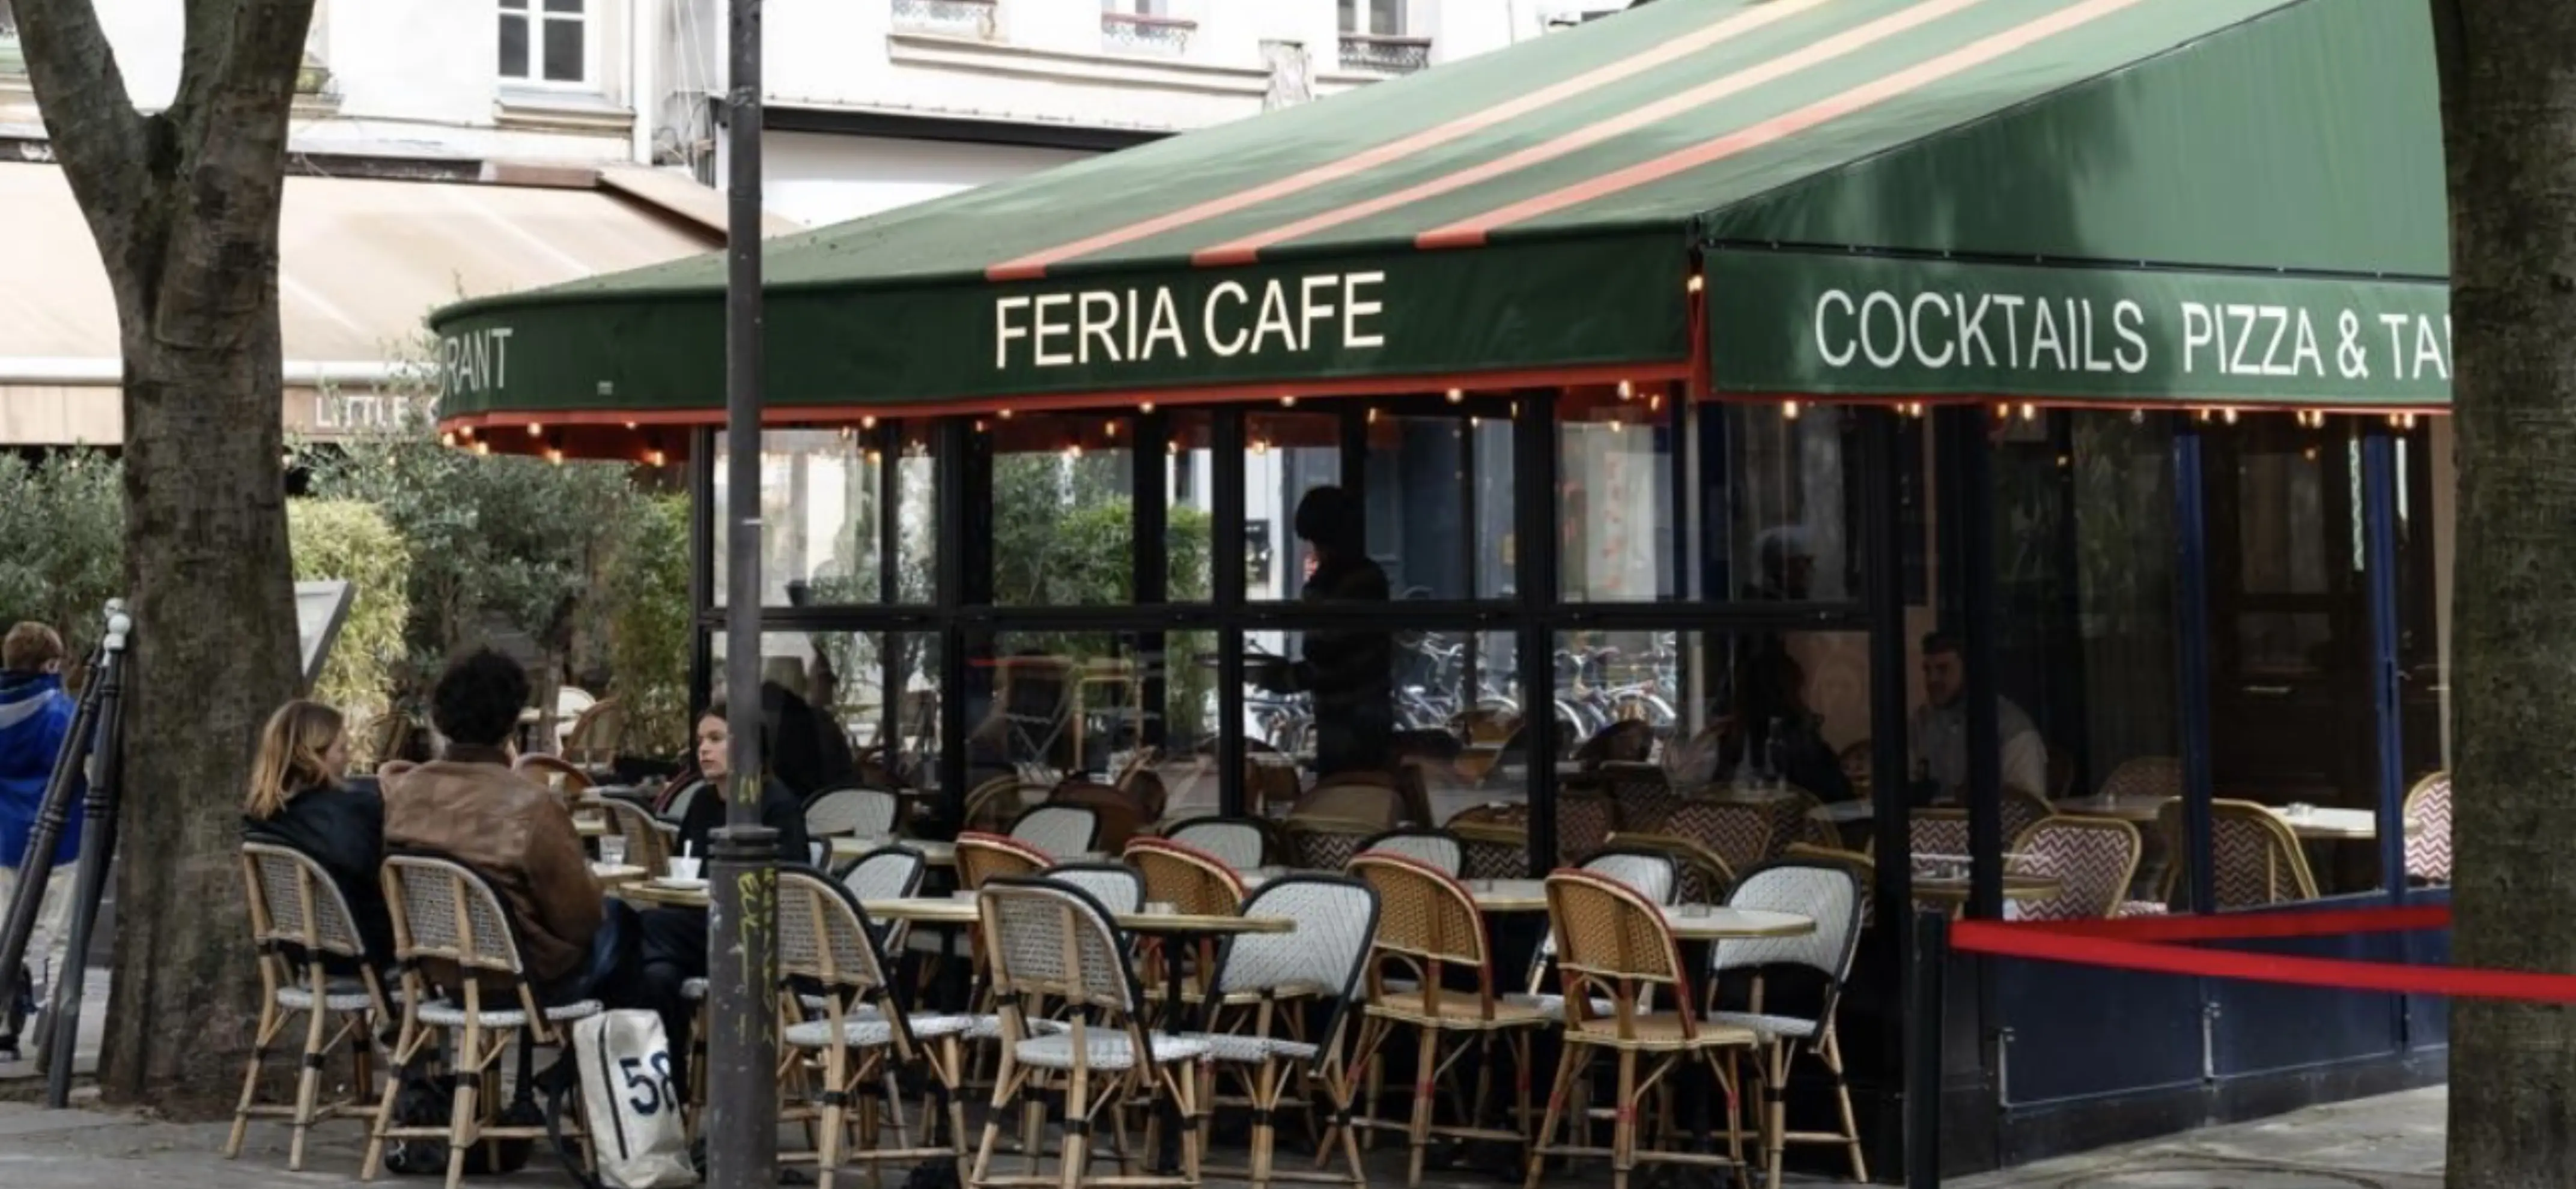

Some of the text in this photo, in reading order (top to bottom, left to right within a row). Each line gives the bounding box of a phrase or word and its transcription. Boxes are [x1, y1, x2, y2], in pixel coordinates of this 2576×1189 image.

[995, 271, 1386, 369] FERIA CAFE
[1814, 289, 2453, 381] COCKTAILS PIZZA & TA
